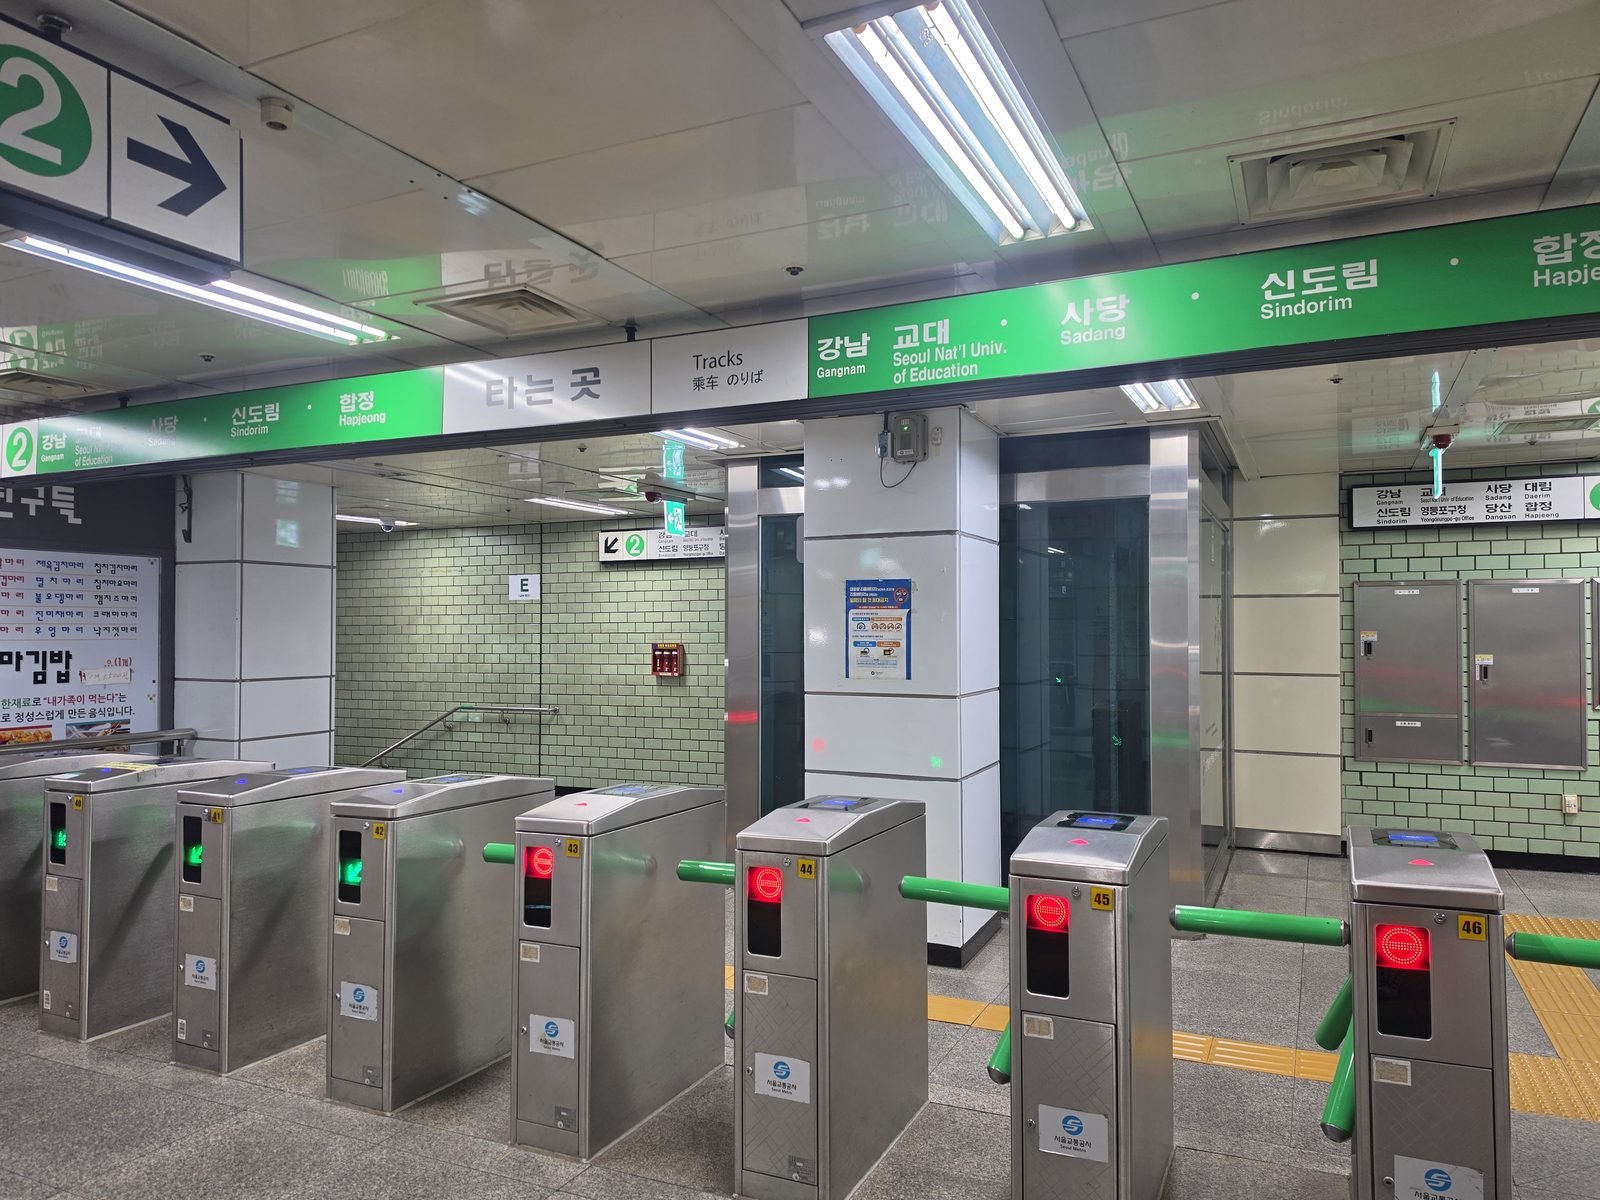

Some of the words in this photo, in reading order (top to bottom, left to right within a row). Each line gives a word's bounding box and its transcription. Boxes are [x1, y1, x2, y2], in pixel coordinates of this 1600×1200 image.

[0, 57, 62, 165] 2
[1261, 259, 1378, 300] 신도림
[1061, 294, 1130, 326] 사당
[1261, 296, 1352, 320] Sindorim
[893, 318, 949, 349] 교대
[1060, 324, 1126, 345] Sadang
[817, 333, 870, 361] 강남
[893, 350, 930, 367] Seoul
[934, 346, 966, 363] Nat'l
[970, 340, 1007, 357] Univ.
[693, 350, 743, 371] Tracks
[692, 374, 719, 391] 乘车
[727, 369, 763, 386] のりば
[816, 363, 866, 379] Gangnam
[893, 370, 906, 385] of
[910, 361, 978, 383] Education
[486, 374, 554, 409] 타는
[570, 366, 602, 402] 곳
[339, 391, 374, 413] 합정
[231, 402, 280, 426] 신도림
[339, 412, 386, 427] Hapjeong
[151, 415, 178, 434] 사당
[231, 424, 268, 438] Sindorim
[12, 431, 27, 468] 2
[42, 433, 67, 451] 강남
[41, 453, 65, 463] Gangnam
[75, 456, 81, 467] of
[83, 455, 113, 467] Education
[1377, 489, 1402, 499] 강남
[1486, 483, 1512, 494] 사당
[1524, 481, 1552, 492] 대림
[1377, 507, 1411, 518] 신도림
[1420, 505, 1466, 516] 영등포구청
[1485, 503, 1512, 513] 당산
[1524, 501, 1552, 511] 합정
[629, 536, 641, 554] 2
[94, 563, 138, 574] 참치김치마리
[94, 579, 138, 590] 참치마요마리
[520, 578, 529, 593] E
[0, 650, 72, 685] 마김밥
[15, 709, 65, 723] 정성스럽게
[68, 708, 87, 719] 만든
[88, 706, 136, 719] 음식입니다.
[374, 825, 384, 836] 42
[567, 842, 578, 854] 43
[799, 863, 813, 876] 44
[1093, 893, 1110, 906] 45
[1461, 920, 1482, 934] 46
[767, 1079, 797, 1091] 서울교통공사
[1054, 1135, 1092, 1148] 서울교통공사
